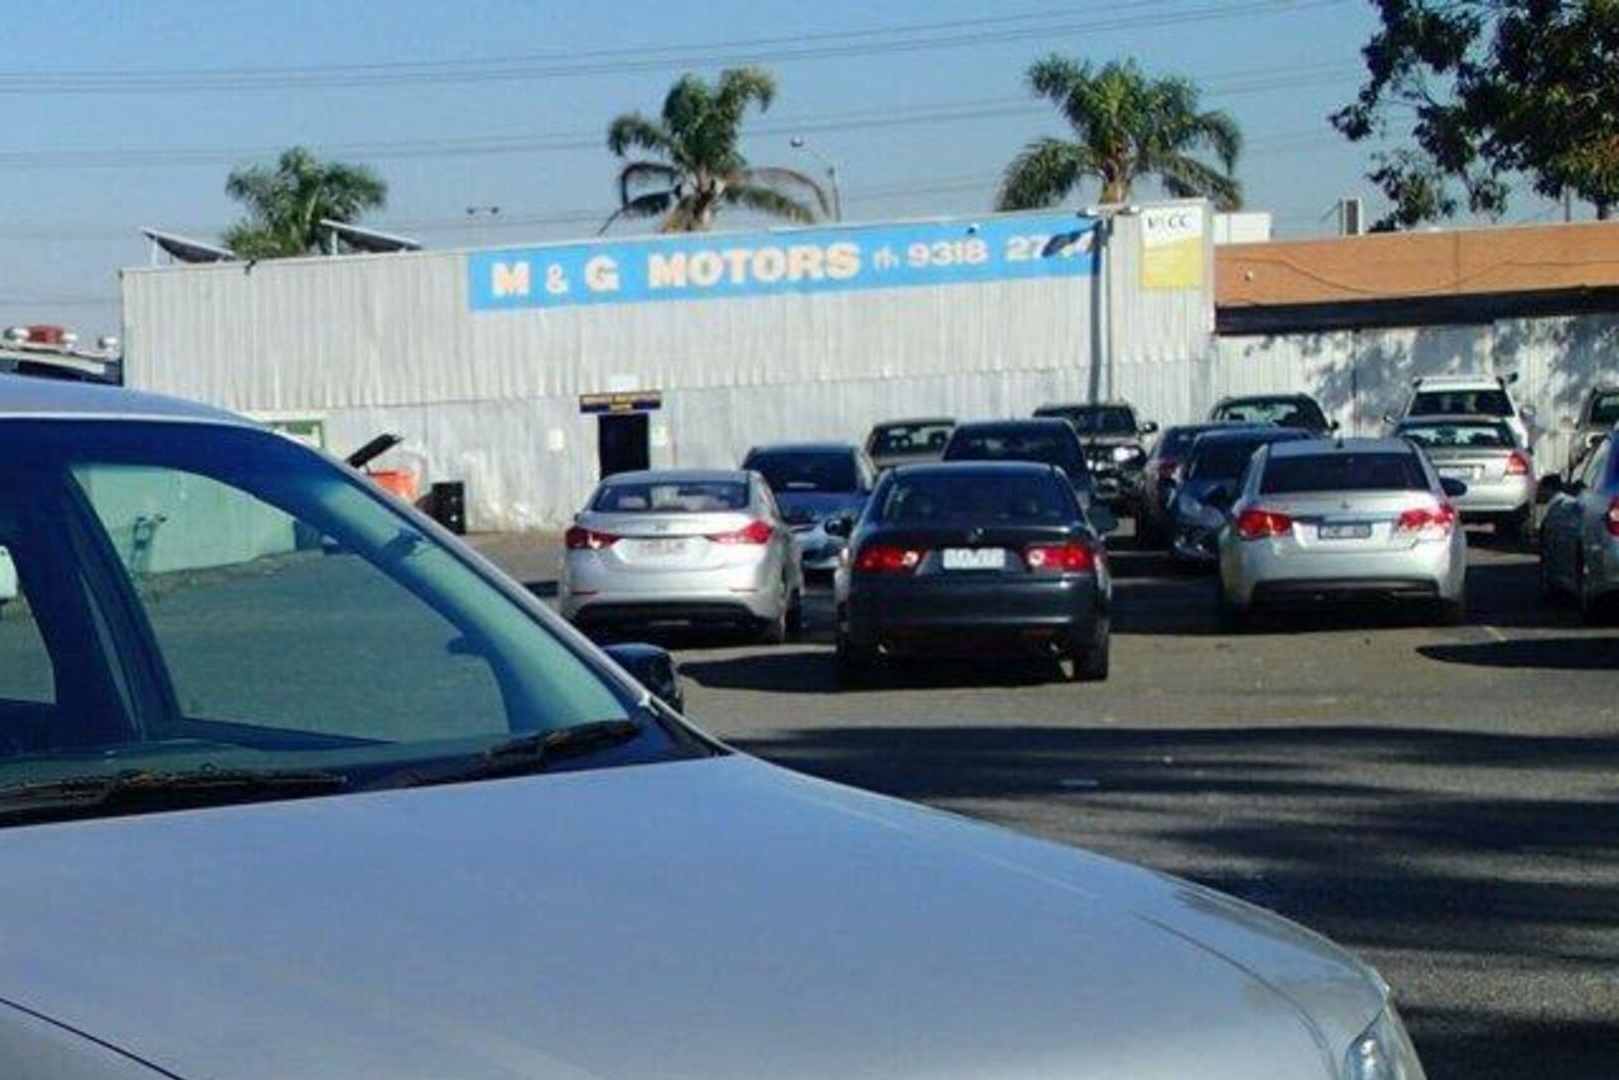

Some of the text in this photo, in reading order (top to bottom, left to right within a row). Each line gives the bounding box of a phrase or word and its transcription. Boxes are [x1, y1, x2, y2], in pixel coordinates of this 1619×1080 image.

[492, 261, 530, 296] M
[545, 263, 570, 294] &
[584, 254, 621, 291] G
[647, 241, 861, 289] MOTORS
[908, 238, 988, 268] 9318
